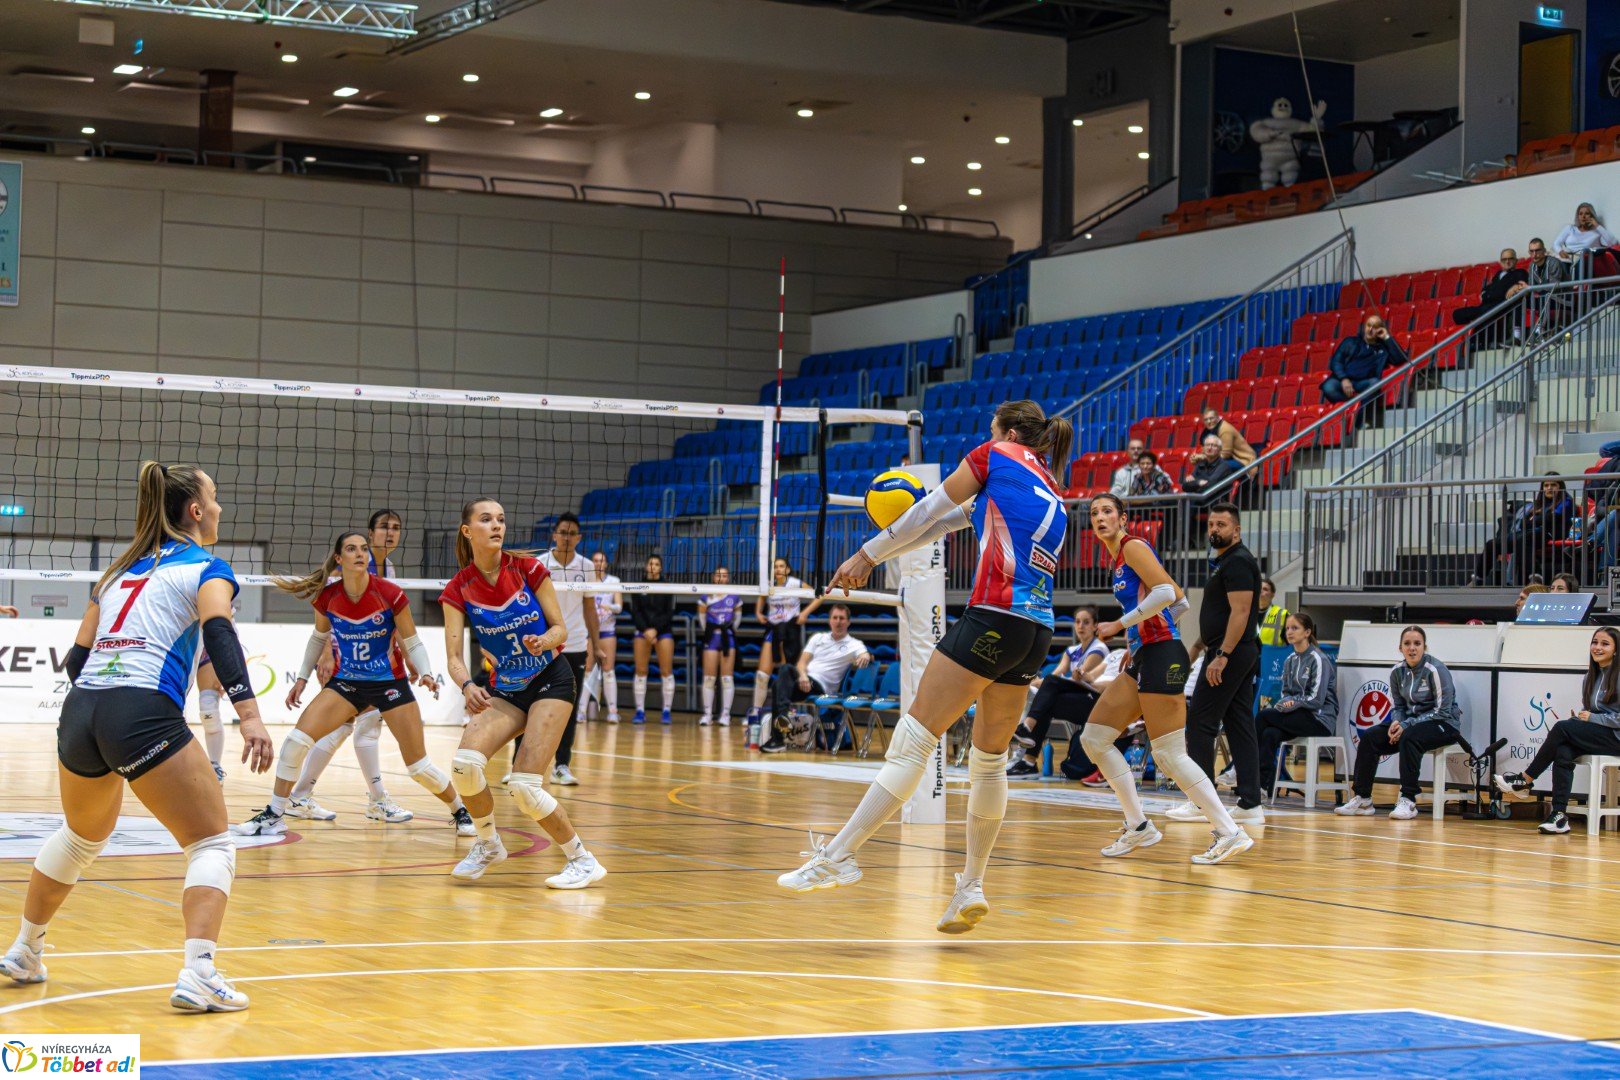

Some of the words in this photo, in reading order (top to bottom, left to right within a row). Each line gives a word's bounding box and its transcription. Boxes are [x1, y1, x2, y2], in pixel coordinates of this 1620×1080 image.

[71, 372, 110, 381] TippmixPRO
[273, 383, 311, 392] TippmixPRO
[108, 577, 150, 634] 7
[475, 610, 540, 636] TippmixPRO
[96, 639, 146, 650] STRABAG
[352, 642, 370, 661] 12
[506, 632, 523, 656] 3
[972, 637, 1003, 661] EAK
[1166, 672, 1185, 681] EAK
[1362, 682, 1389, 695] FATUM
[117, 740, 169, 773] TippmixPRO
